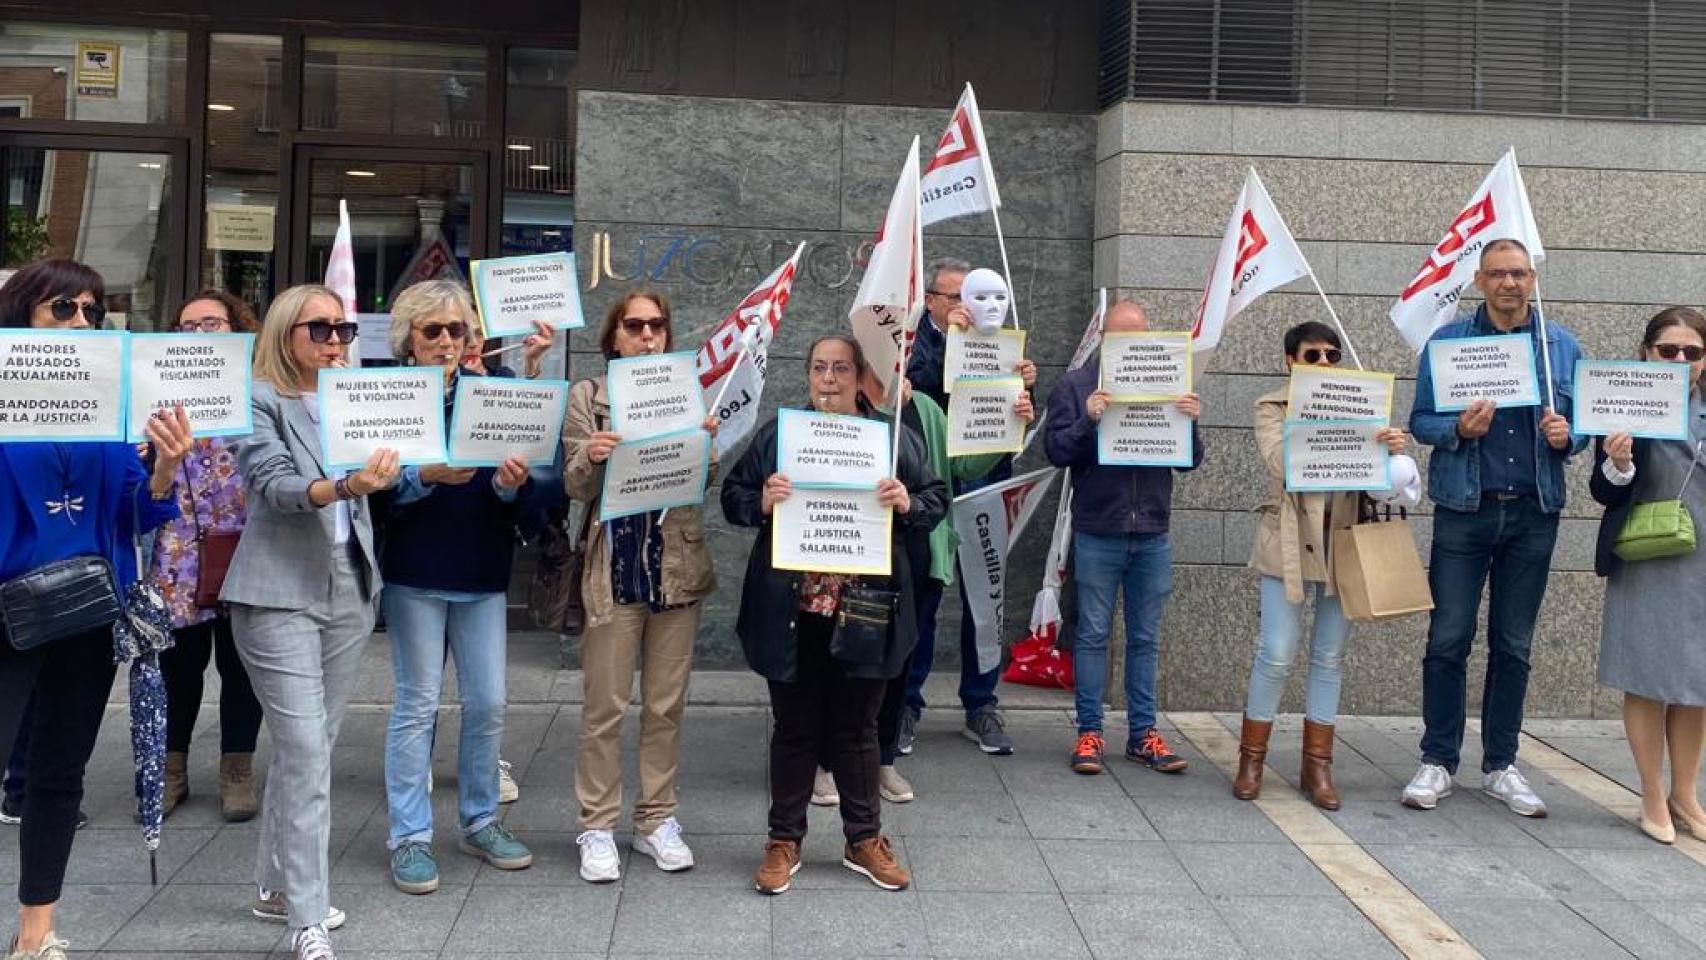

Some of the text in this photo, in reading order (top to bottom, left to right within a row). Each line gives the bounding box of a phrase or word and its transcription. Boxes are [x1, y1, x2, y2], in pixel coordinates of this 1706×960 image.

[11, 345, 76, 354] MENORES
[964, 342, 1000, 350] PERSONAL
[166, 347, 214, 356] MENORES
[965, 352, 998, 360] LABORAL
[6, 357, 81, 367] ABUSADOS
[1451, 353, 1511, 362] MALTRATADOS
[154, 358, 225, 368] MALTRATADOS
[969, 362, 1000, 370] JUSTICIA
[631, 365, 672, 376] PADRES SIN
[1589, 370, 1628, 378] EQUIPOS
[0, 372, 90, 381] EXUALMENTE
[636, 375, 671, 386] CUSTODIA
[336, 380, 427, 390] MUJERES VÍCTIMAS
[1321, 383, 1361, 392] MENORES
[1608, 380, 1654, 388] FORENSES
[349, 392, 415, 402] DE VIOLENCIA
[473, 388, 554, 400] MUJERES VÍCTIMAS
[1312, 392, 1368, 403] INFRACTORES
[0, 400, 98, 409] BANDONADOS
[497, 400, 542, 409] VIOLENCIA
[1311, 403, 1374, 415] ABANDONADOS
[971, 406, 1002, 414] LABORAL
[12, 413, 29, 422] LA
[644, 411, 652, 419] LA
[810, 422, 845, 430] PADRES
[344, 431, 365, 439] POR
[367, 429, 379, 438] LA
[470, 432, 489, 441] POR
[492, 433, 504, 441] LA
[814, 430, 859, 440] CUSTODIA
[963, 430, 998, 440] SALARIAL
[638, 445, 669, 456] PADRES
[640, 452, 680, 465] CUSTODIA
[619, 486, 638, 494] POR
[806, 501, 860, 510] PERSONAL
[809, 514, 855, 523] LABORAL
[813, 529, 861, 539] JUSTICIA
[800, 544, 852, 554] SALARIAL
[975, 511, 1001, 586] Castilla
